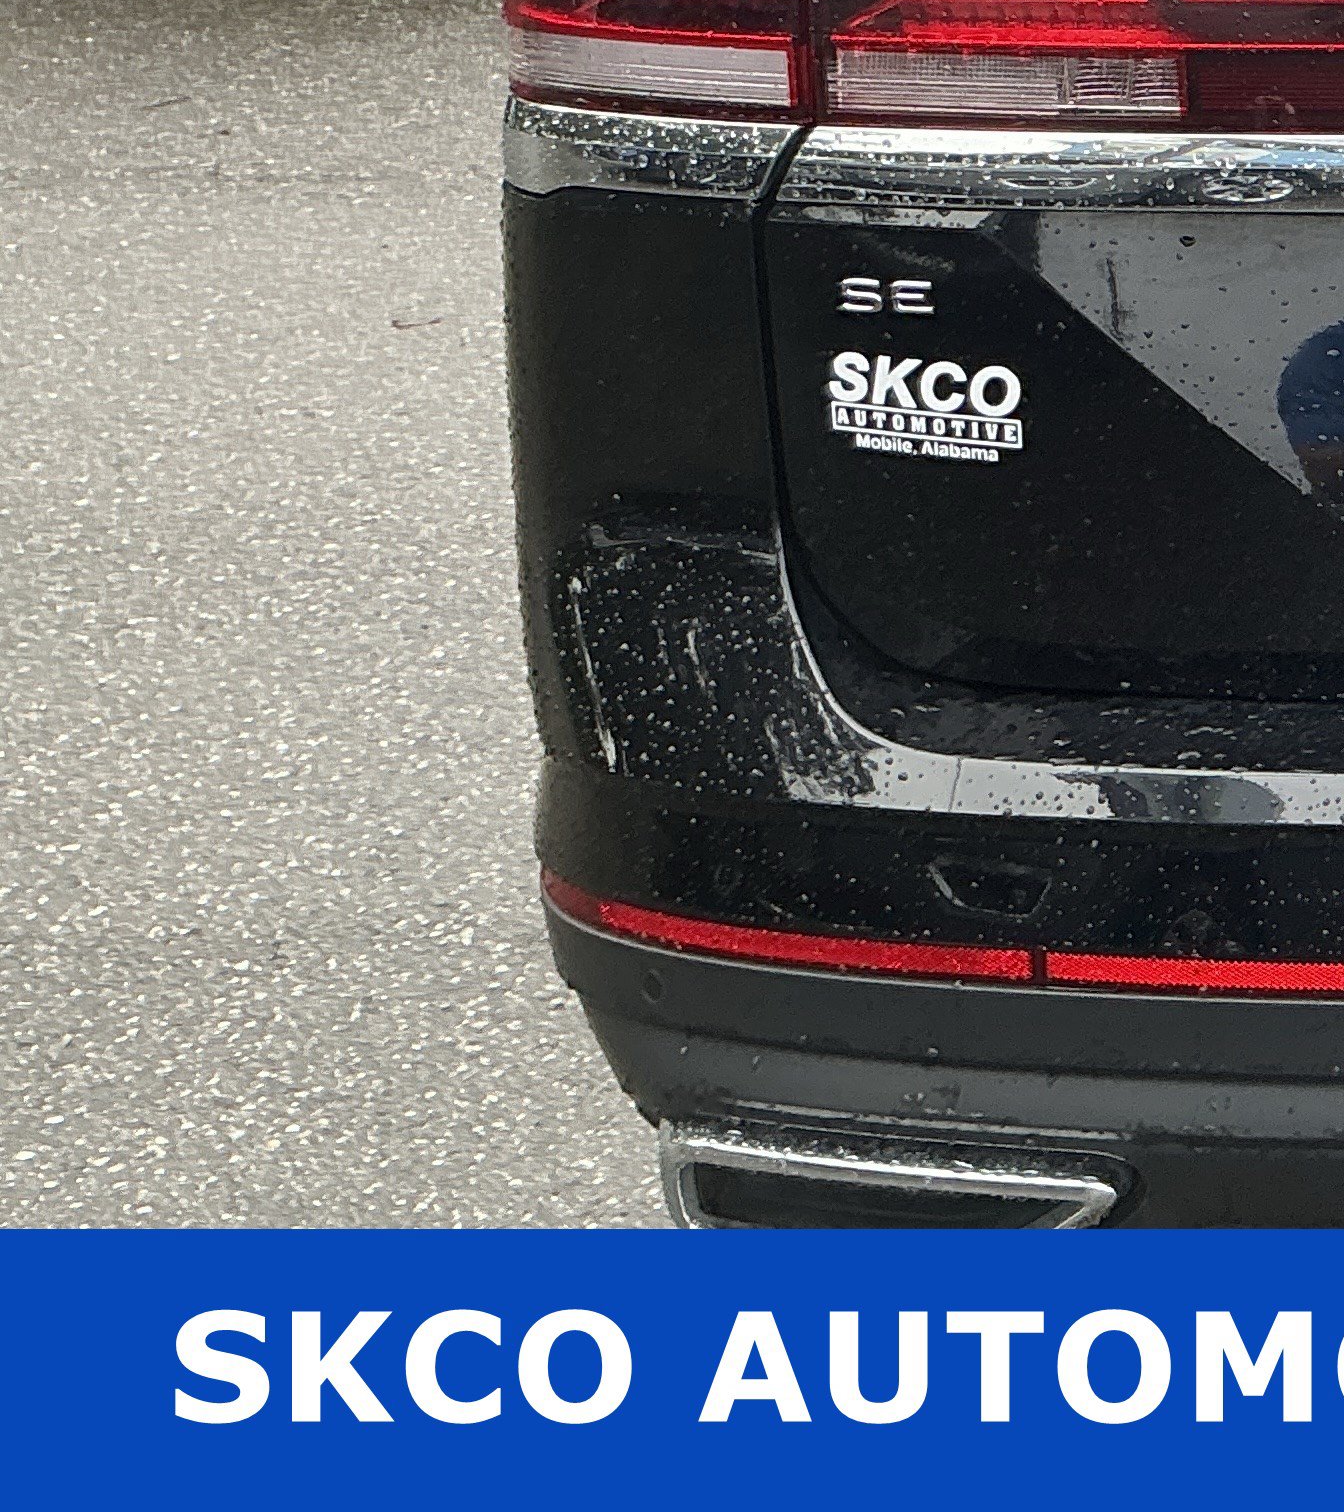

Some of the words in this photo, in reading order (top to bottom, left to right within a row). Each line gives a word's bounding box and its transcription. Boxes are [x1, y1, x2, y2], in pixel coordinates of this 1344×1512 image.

[837, 277, 935, 315] SE
[828, 351, 1022, 417] SKCO
[836, 406, 1018, 443] AUTOMOTIVE
[855, 433, 918, 456] Mobile,
[921, 440, 1000, 463] Alabama
